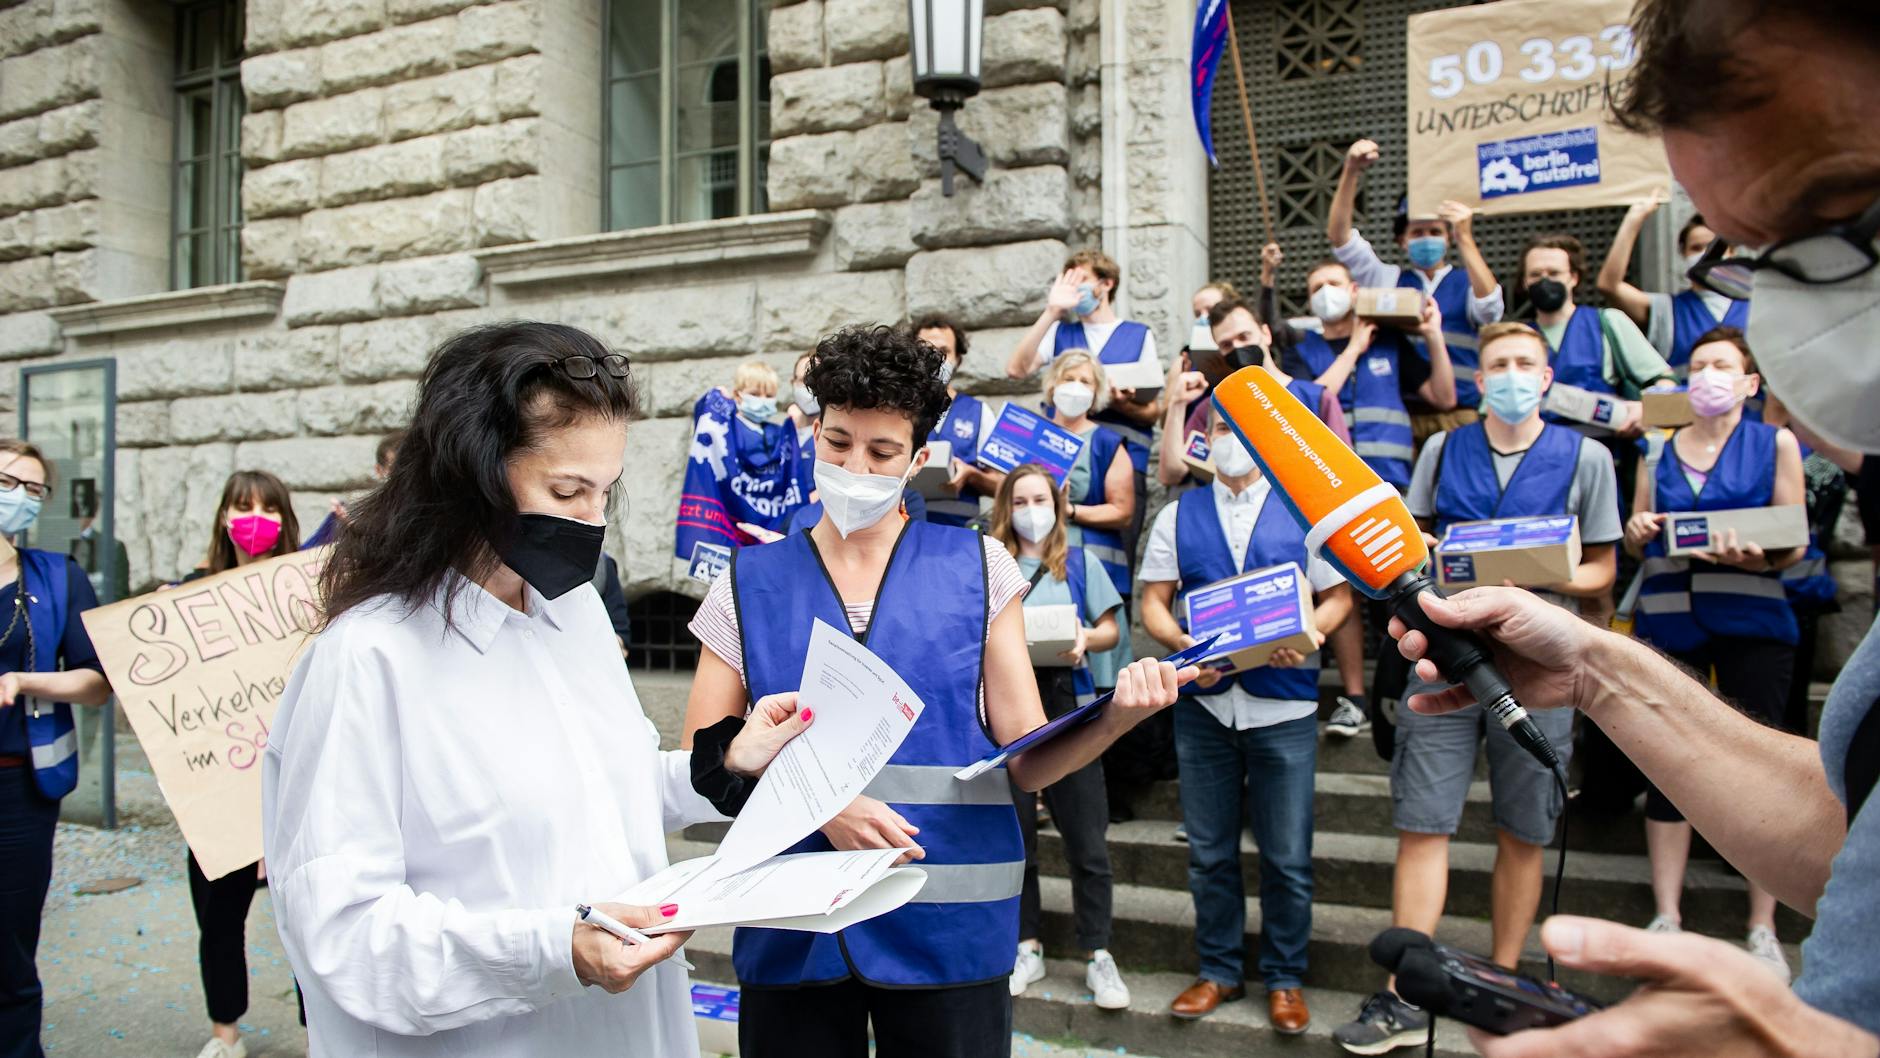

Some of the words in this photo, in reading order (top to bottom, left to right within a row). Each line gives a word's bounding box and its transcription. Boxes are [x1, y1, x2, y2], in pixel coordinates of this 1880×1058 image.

[1428, 40, 1503, 99] 50
[1519, 24, 1637, 83] 333
[1523, 149, 1570, 171] berlin
[1531, 158, 1599, 184] autofrei
[1246, 381, 1274, 410] Kultur
[1270, 408, 1343, 488] Deutschlandfunk
[149, 669, 286, 736] Verkehrs
[183, 751, 219, 772] im
